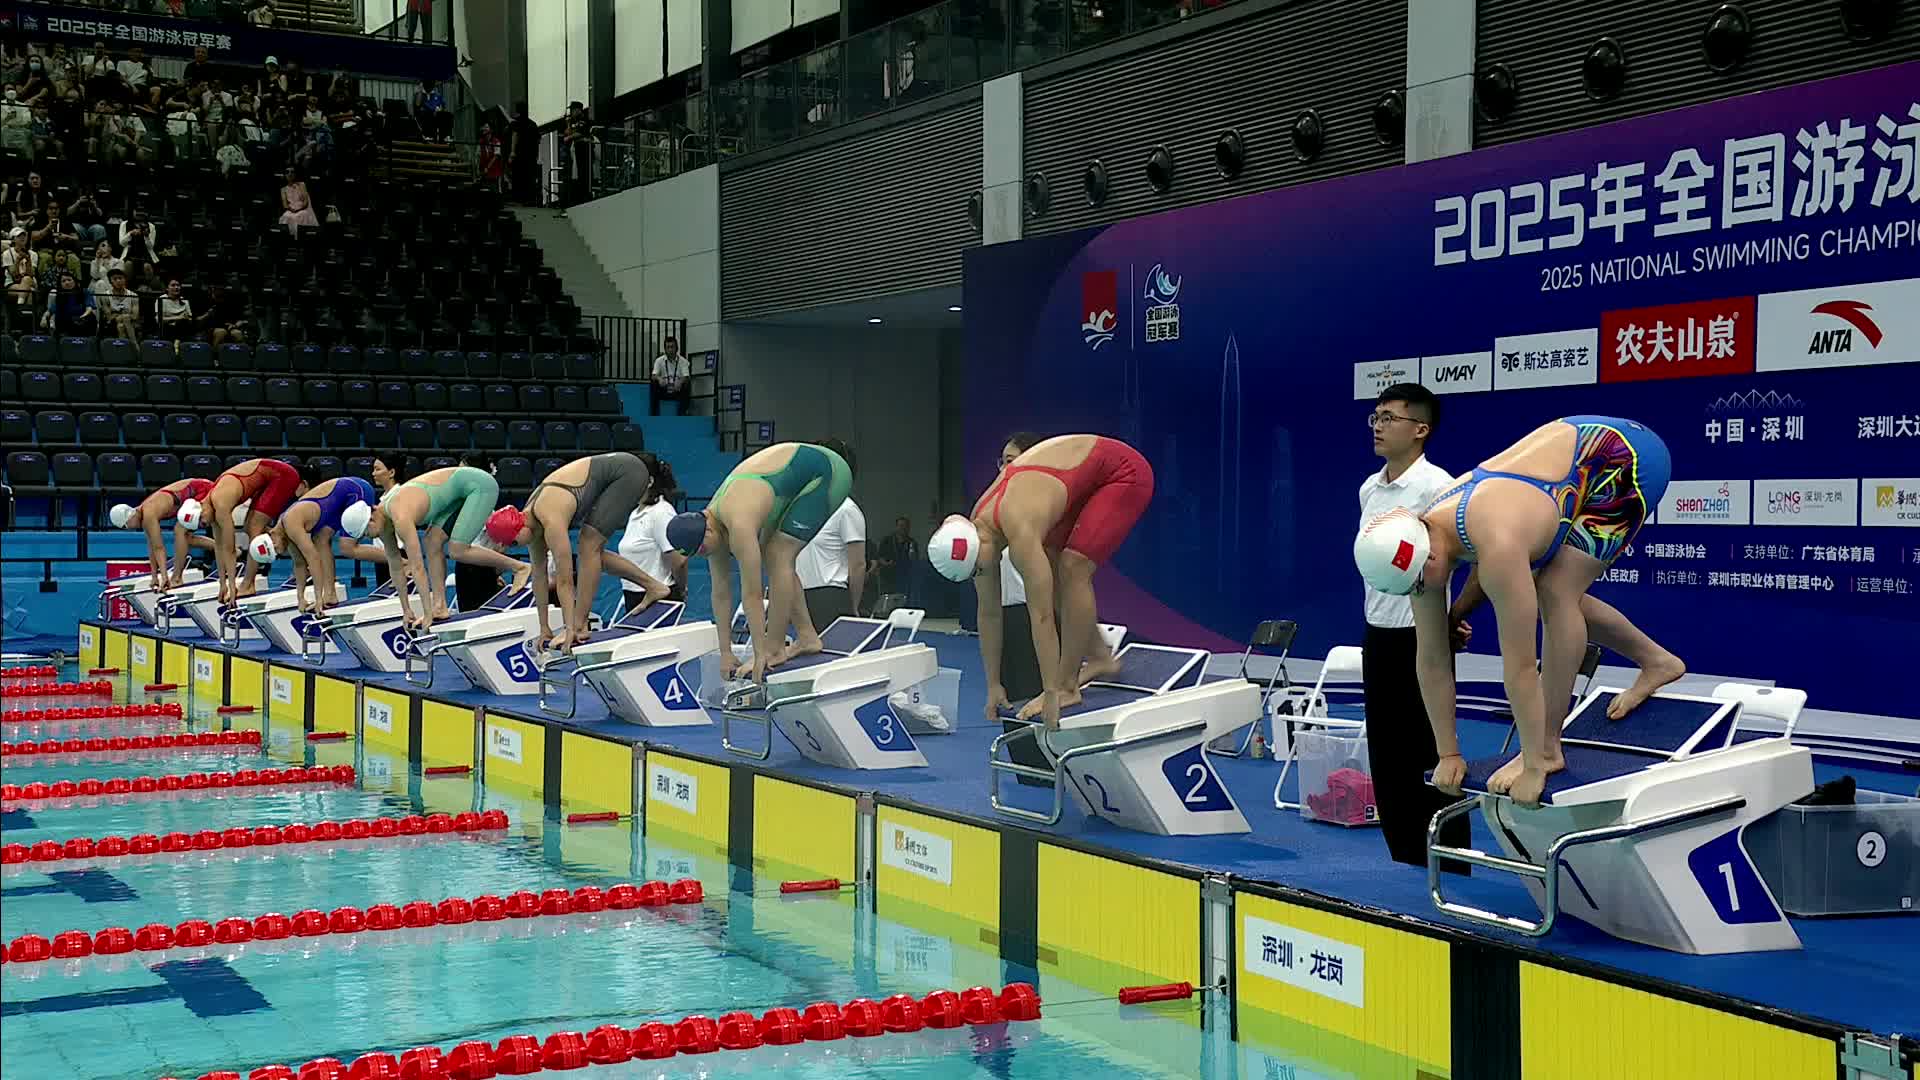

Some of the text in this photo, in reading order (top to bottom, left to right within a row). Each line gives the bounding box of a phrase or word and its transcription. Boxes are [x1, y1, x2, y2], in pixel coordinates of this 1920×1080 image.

[47, 17, 232, 50] 2025年全国游泳冠军赛
[1541, 219, 1920, 291] 2025 NATIONAL SWIMMING CHAMPI
[1615, 315, 1736, 366] 农夫山泉
[1808, 328, 1852, 355] ANTA
[1523, 346, 1590, 371] 斯达高瓷艺
[1435, 364, 1477, 383] UMAY
[1767, 502, 1800, 513] GANG
[1768, 491, 1800, 503] LONG
[1644, 543, 1706, 559] 中国游泳协会
[1801, 544, 1875, 563] 广东省体育局
[1595, 568, 1639, 583] 人民政府
[1707, 571, 1834, 591] 深圳市职业体育管理中心
[393, 633, 407, 654] 6
[510, 654, 528, 678] 5
[663, 677, 684, 703] 4
[912, 693, 920, 703] 5
[876, 715, 894, 744] 3
[1185, 763, 1208, 803] 2
[1866, 840, 1877, 859] 2
[1719, 861, 1740, 912] 1
[1262, 934, 1343, 986] 深圳·龙岗
